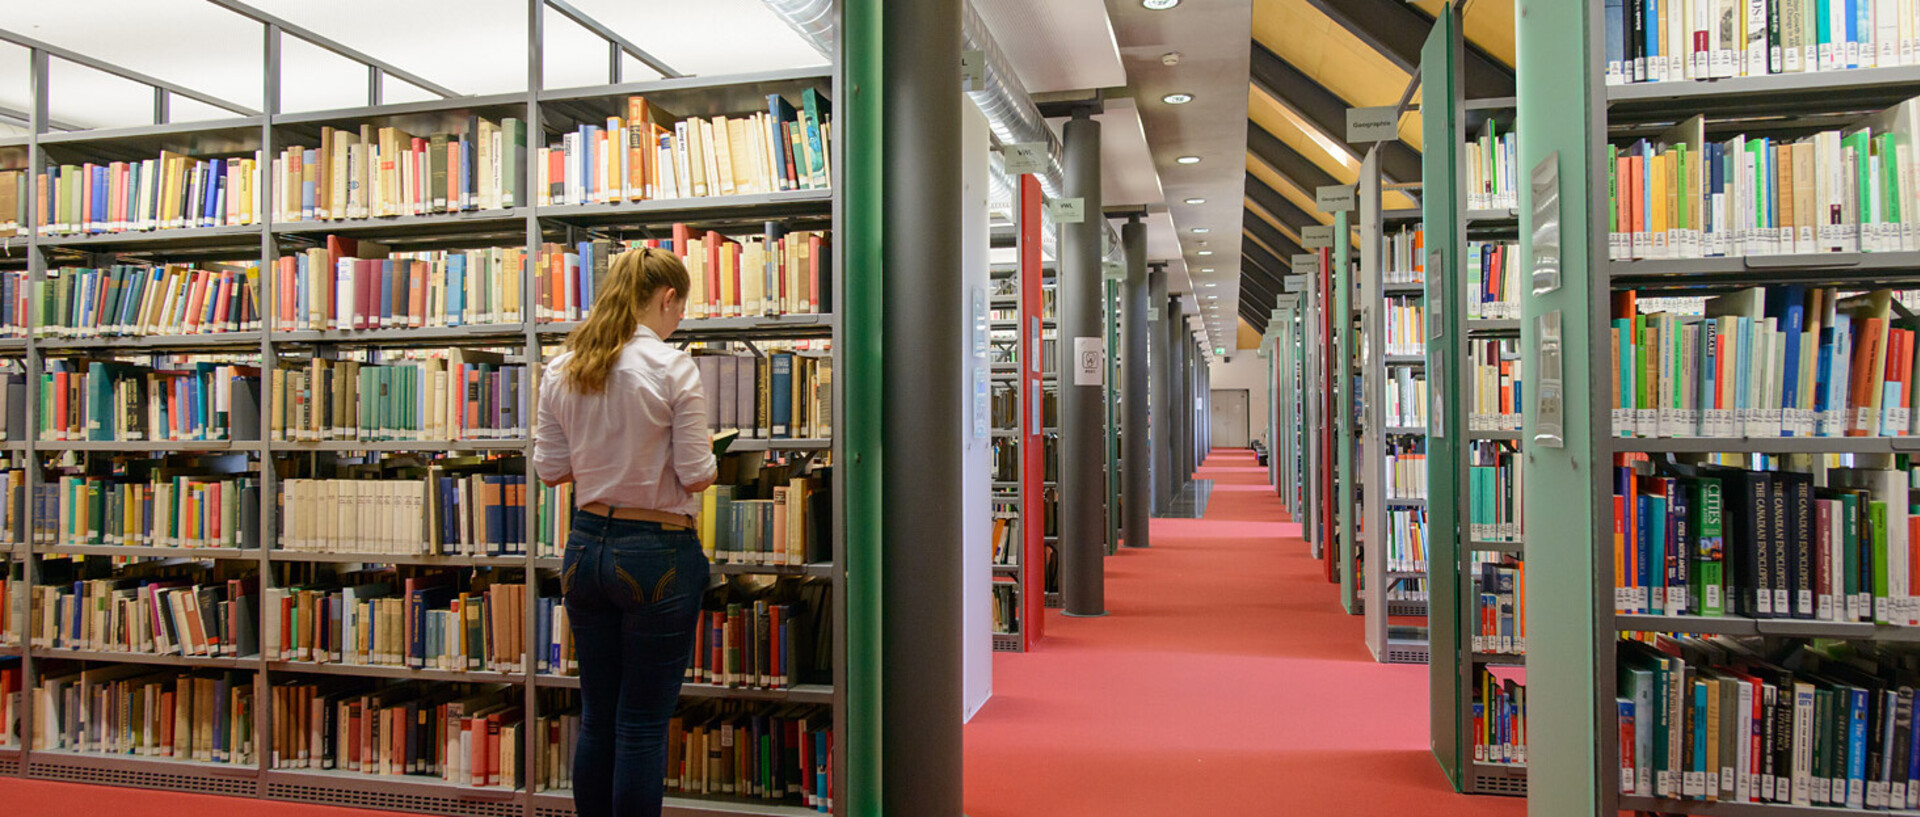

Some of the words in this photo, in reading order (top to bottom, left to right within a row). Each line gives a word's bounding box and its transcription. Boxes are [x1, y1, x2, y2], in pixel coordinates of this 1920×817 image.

[1353, 120, 1391, 129] Geographie
[1708, 484, 1720, 524] CITIES
[1756, 482, 1766, 497] THE
[1774, 482, 1783, 497] THE
[1798, 482, 1808, 497] THE
[1756, 498, 1767, 540] CANADIAN
[1774, 498, 1784, 540] CANADIAN
[1798, 498, 1808, 540] CANADIAN
[1896, 686, 1914, 730] CITY
[1856, 723, 1864, 737] The
[1854, 740, 1862, 776] American
